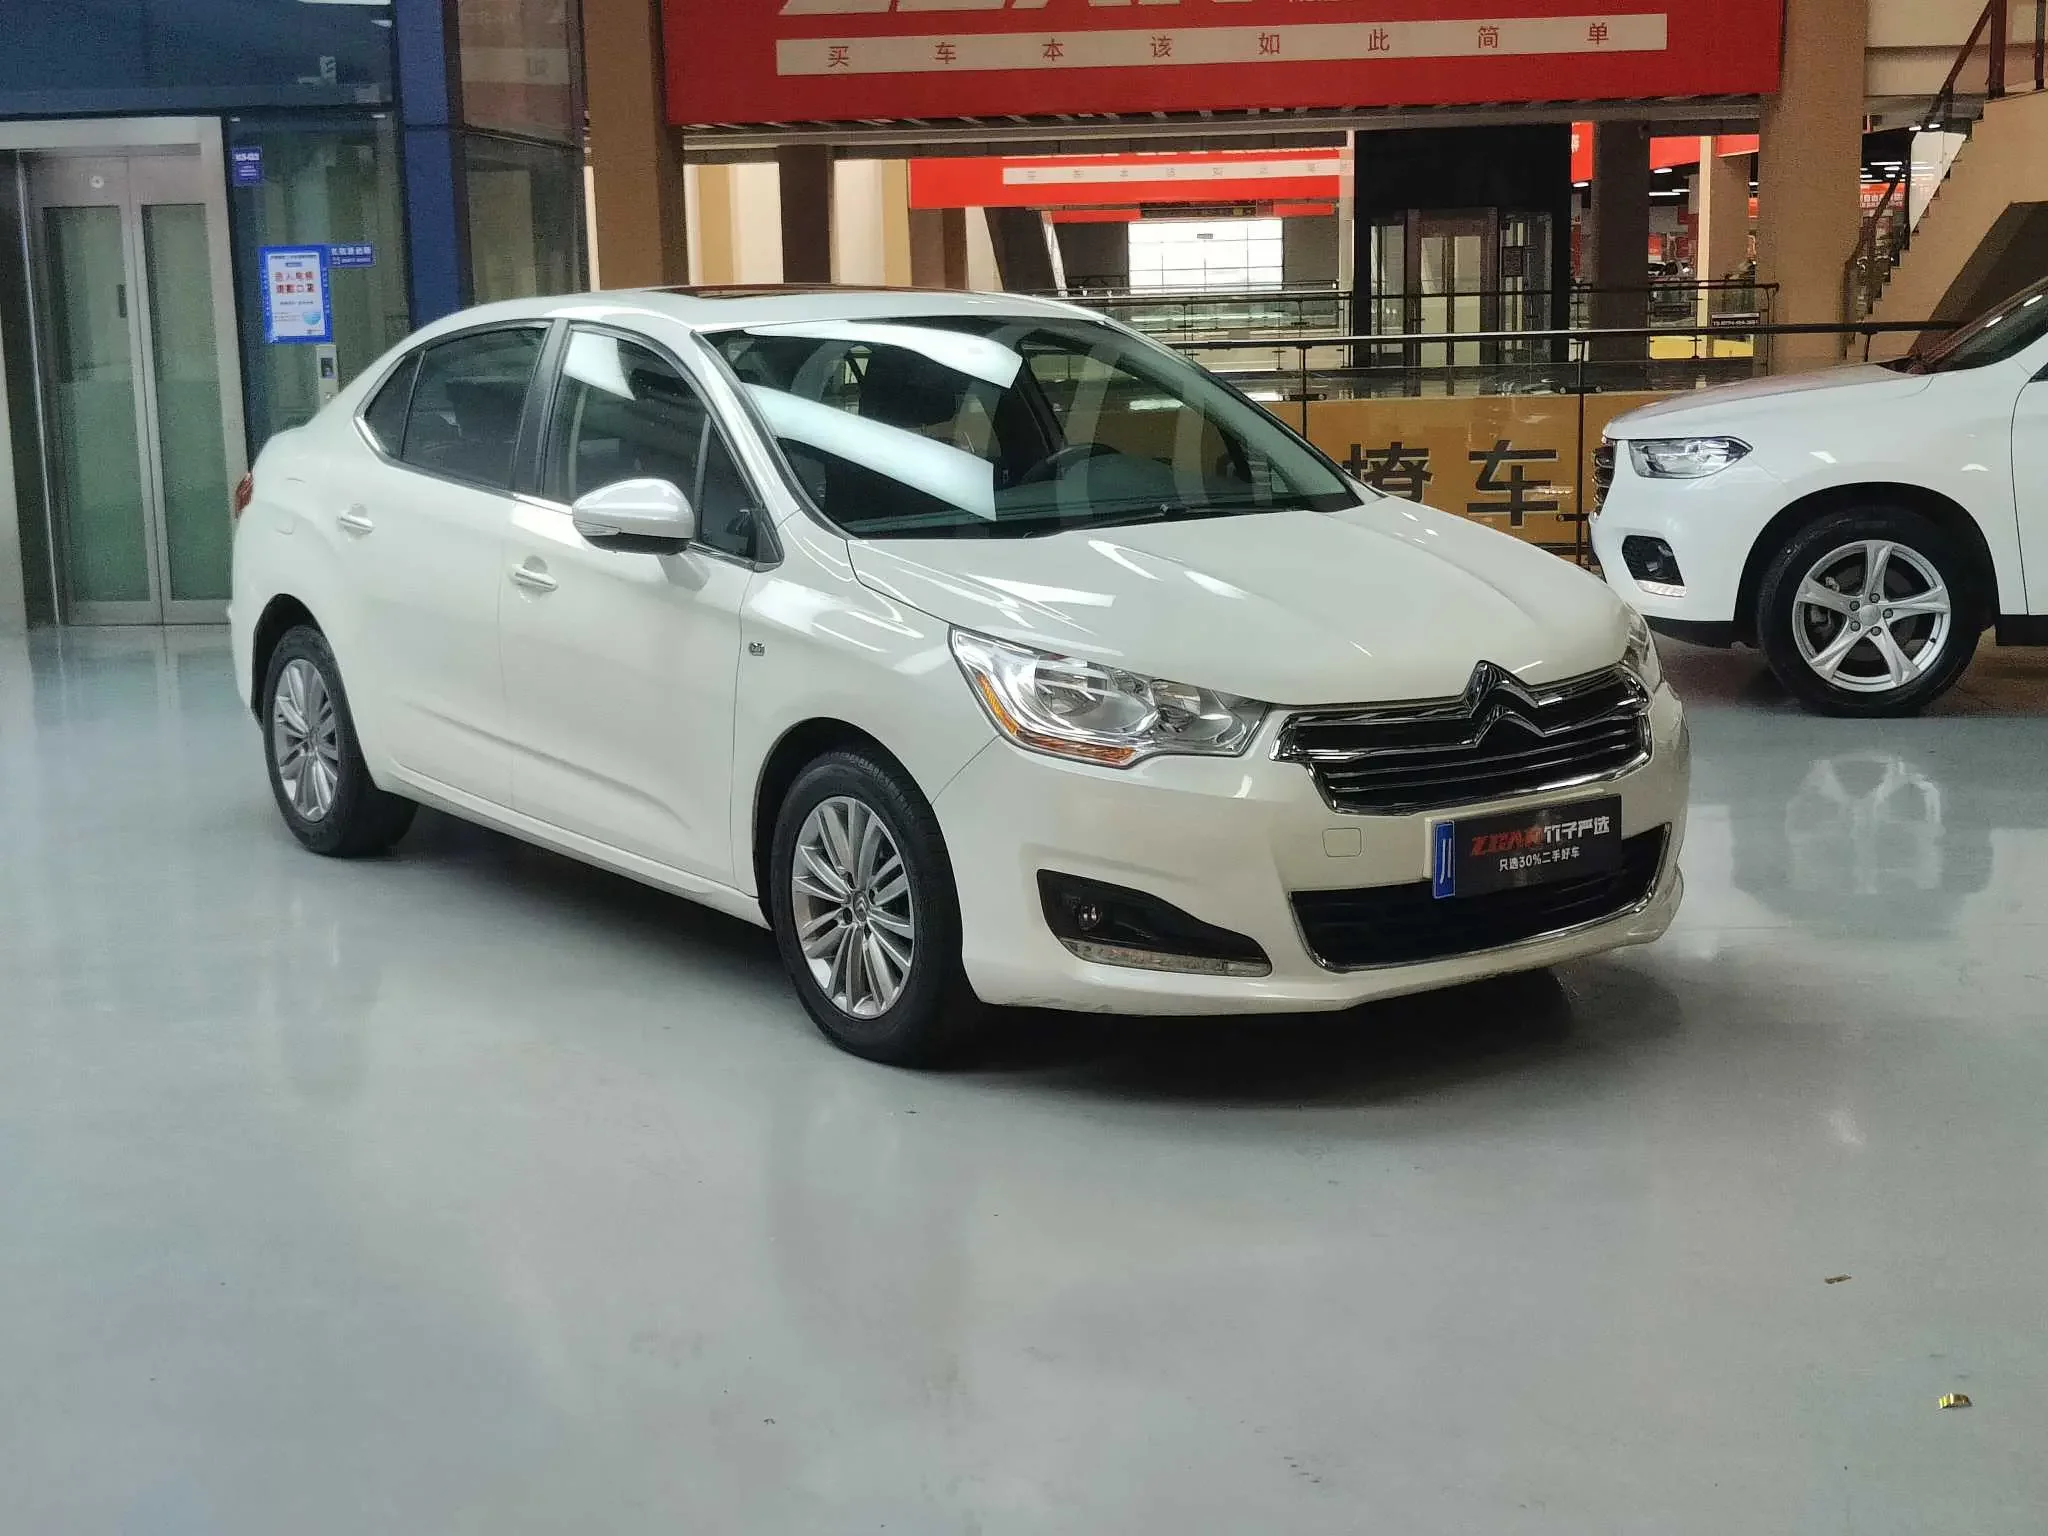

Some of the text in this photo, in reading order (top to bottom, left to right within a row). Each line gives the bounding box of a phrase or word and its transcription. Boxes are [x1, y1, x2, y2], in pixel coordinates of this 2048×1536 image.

[826, 22, 1611, 69] 买车本该如此简单
